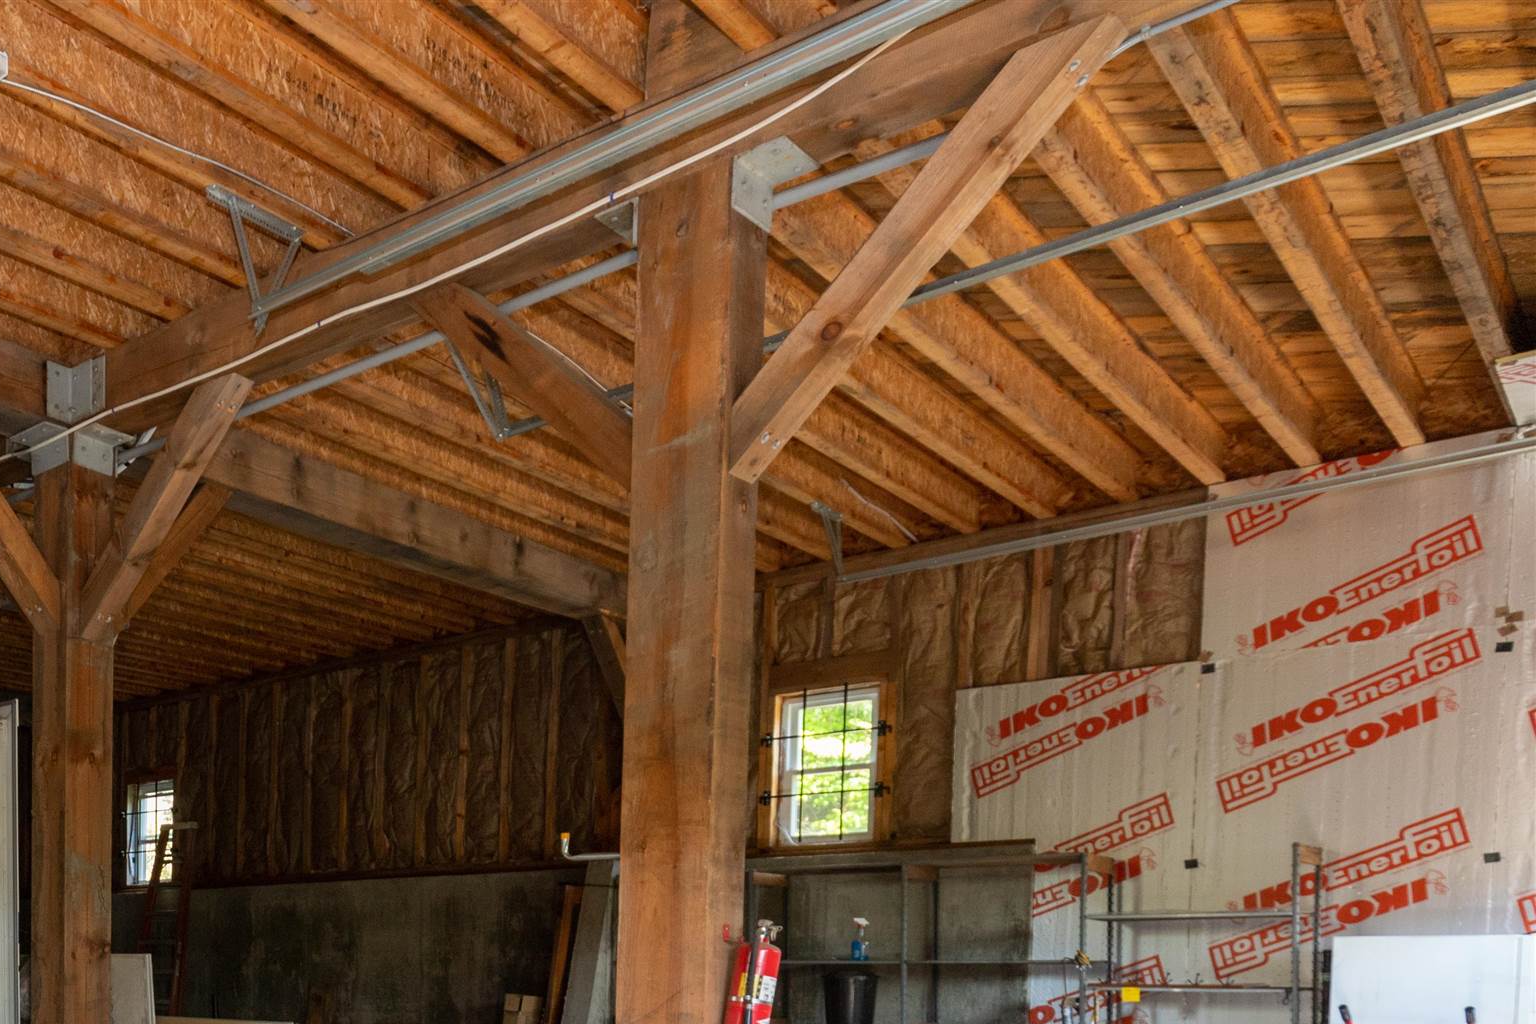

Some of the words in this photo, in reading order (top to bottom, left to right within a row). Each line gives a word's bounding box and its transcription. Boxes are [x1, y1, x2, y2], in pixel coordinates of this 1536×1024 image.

[1252, 596, 1339, 650] IKO
[1336, 514, 1483, 614] Enerfoil
[1347, 589, 1440, 643] IKO
[999, 694, 1068, 740] IKO
[1075, 693, 1149, 740] IKO
[1251, 698, 1338, 748] IKO
[1335, 628, 1481, 717] Enerfoil
[1346, 696, 1440, 748] IKO
[971, 722, 1083, 799] Enerfoil
[1216, 729, 1355, 813] Enerfoil
[1054, 792, 1175, 855] nerfoil
[1323, 808, 1470, 892] Enerfoil
[1337, 877, 1429, 924] IKO
